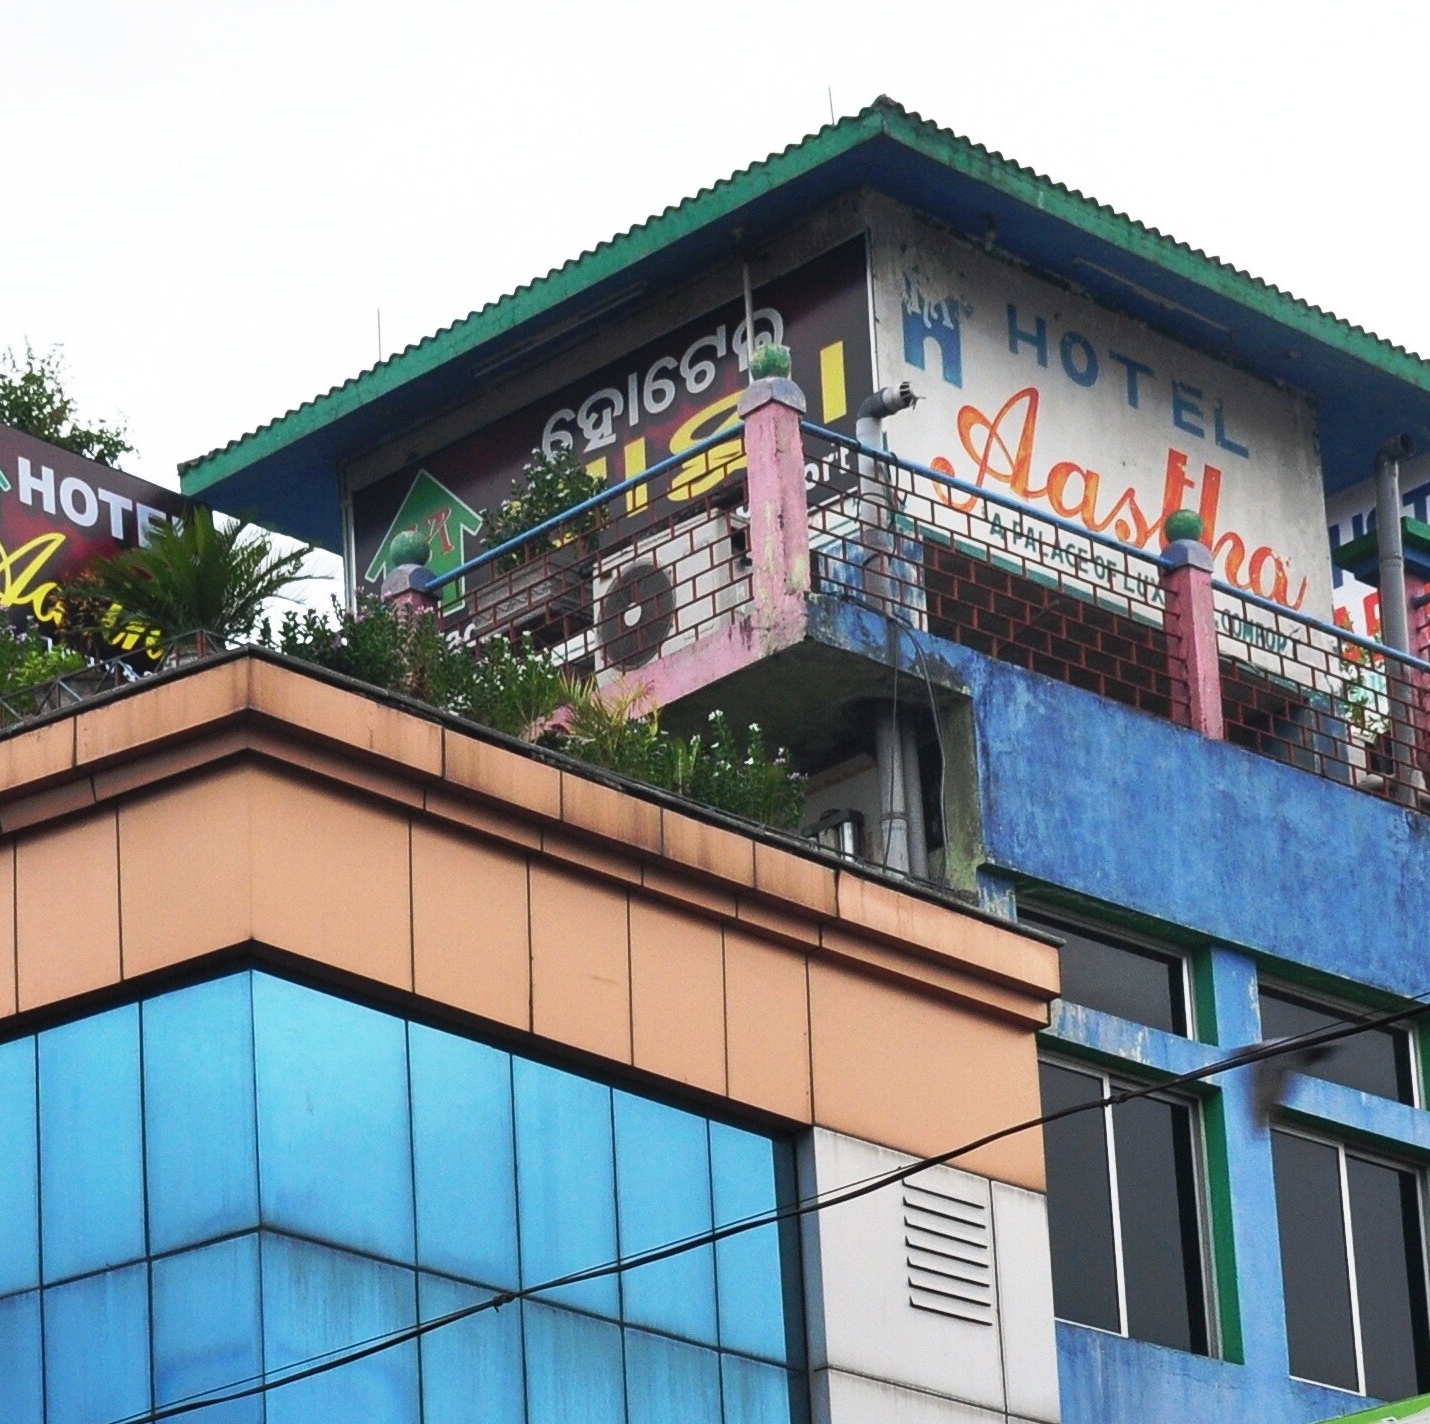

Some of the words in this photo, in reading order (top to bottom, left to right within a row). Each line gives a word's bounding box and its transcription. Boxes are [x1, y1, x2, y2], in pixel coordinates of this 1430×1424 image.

[1006, 303, 1249, 458] HOTEL
[17, 456, 187, 548] HOTE
[930, 386, 1309, 611] Aastha
[989, 512, 1005, 541] A
[1122, 572, 1165, 606] LUX
